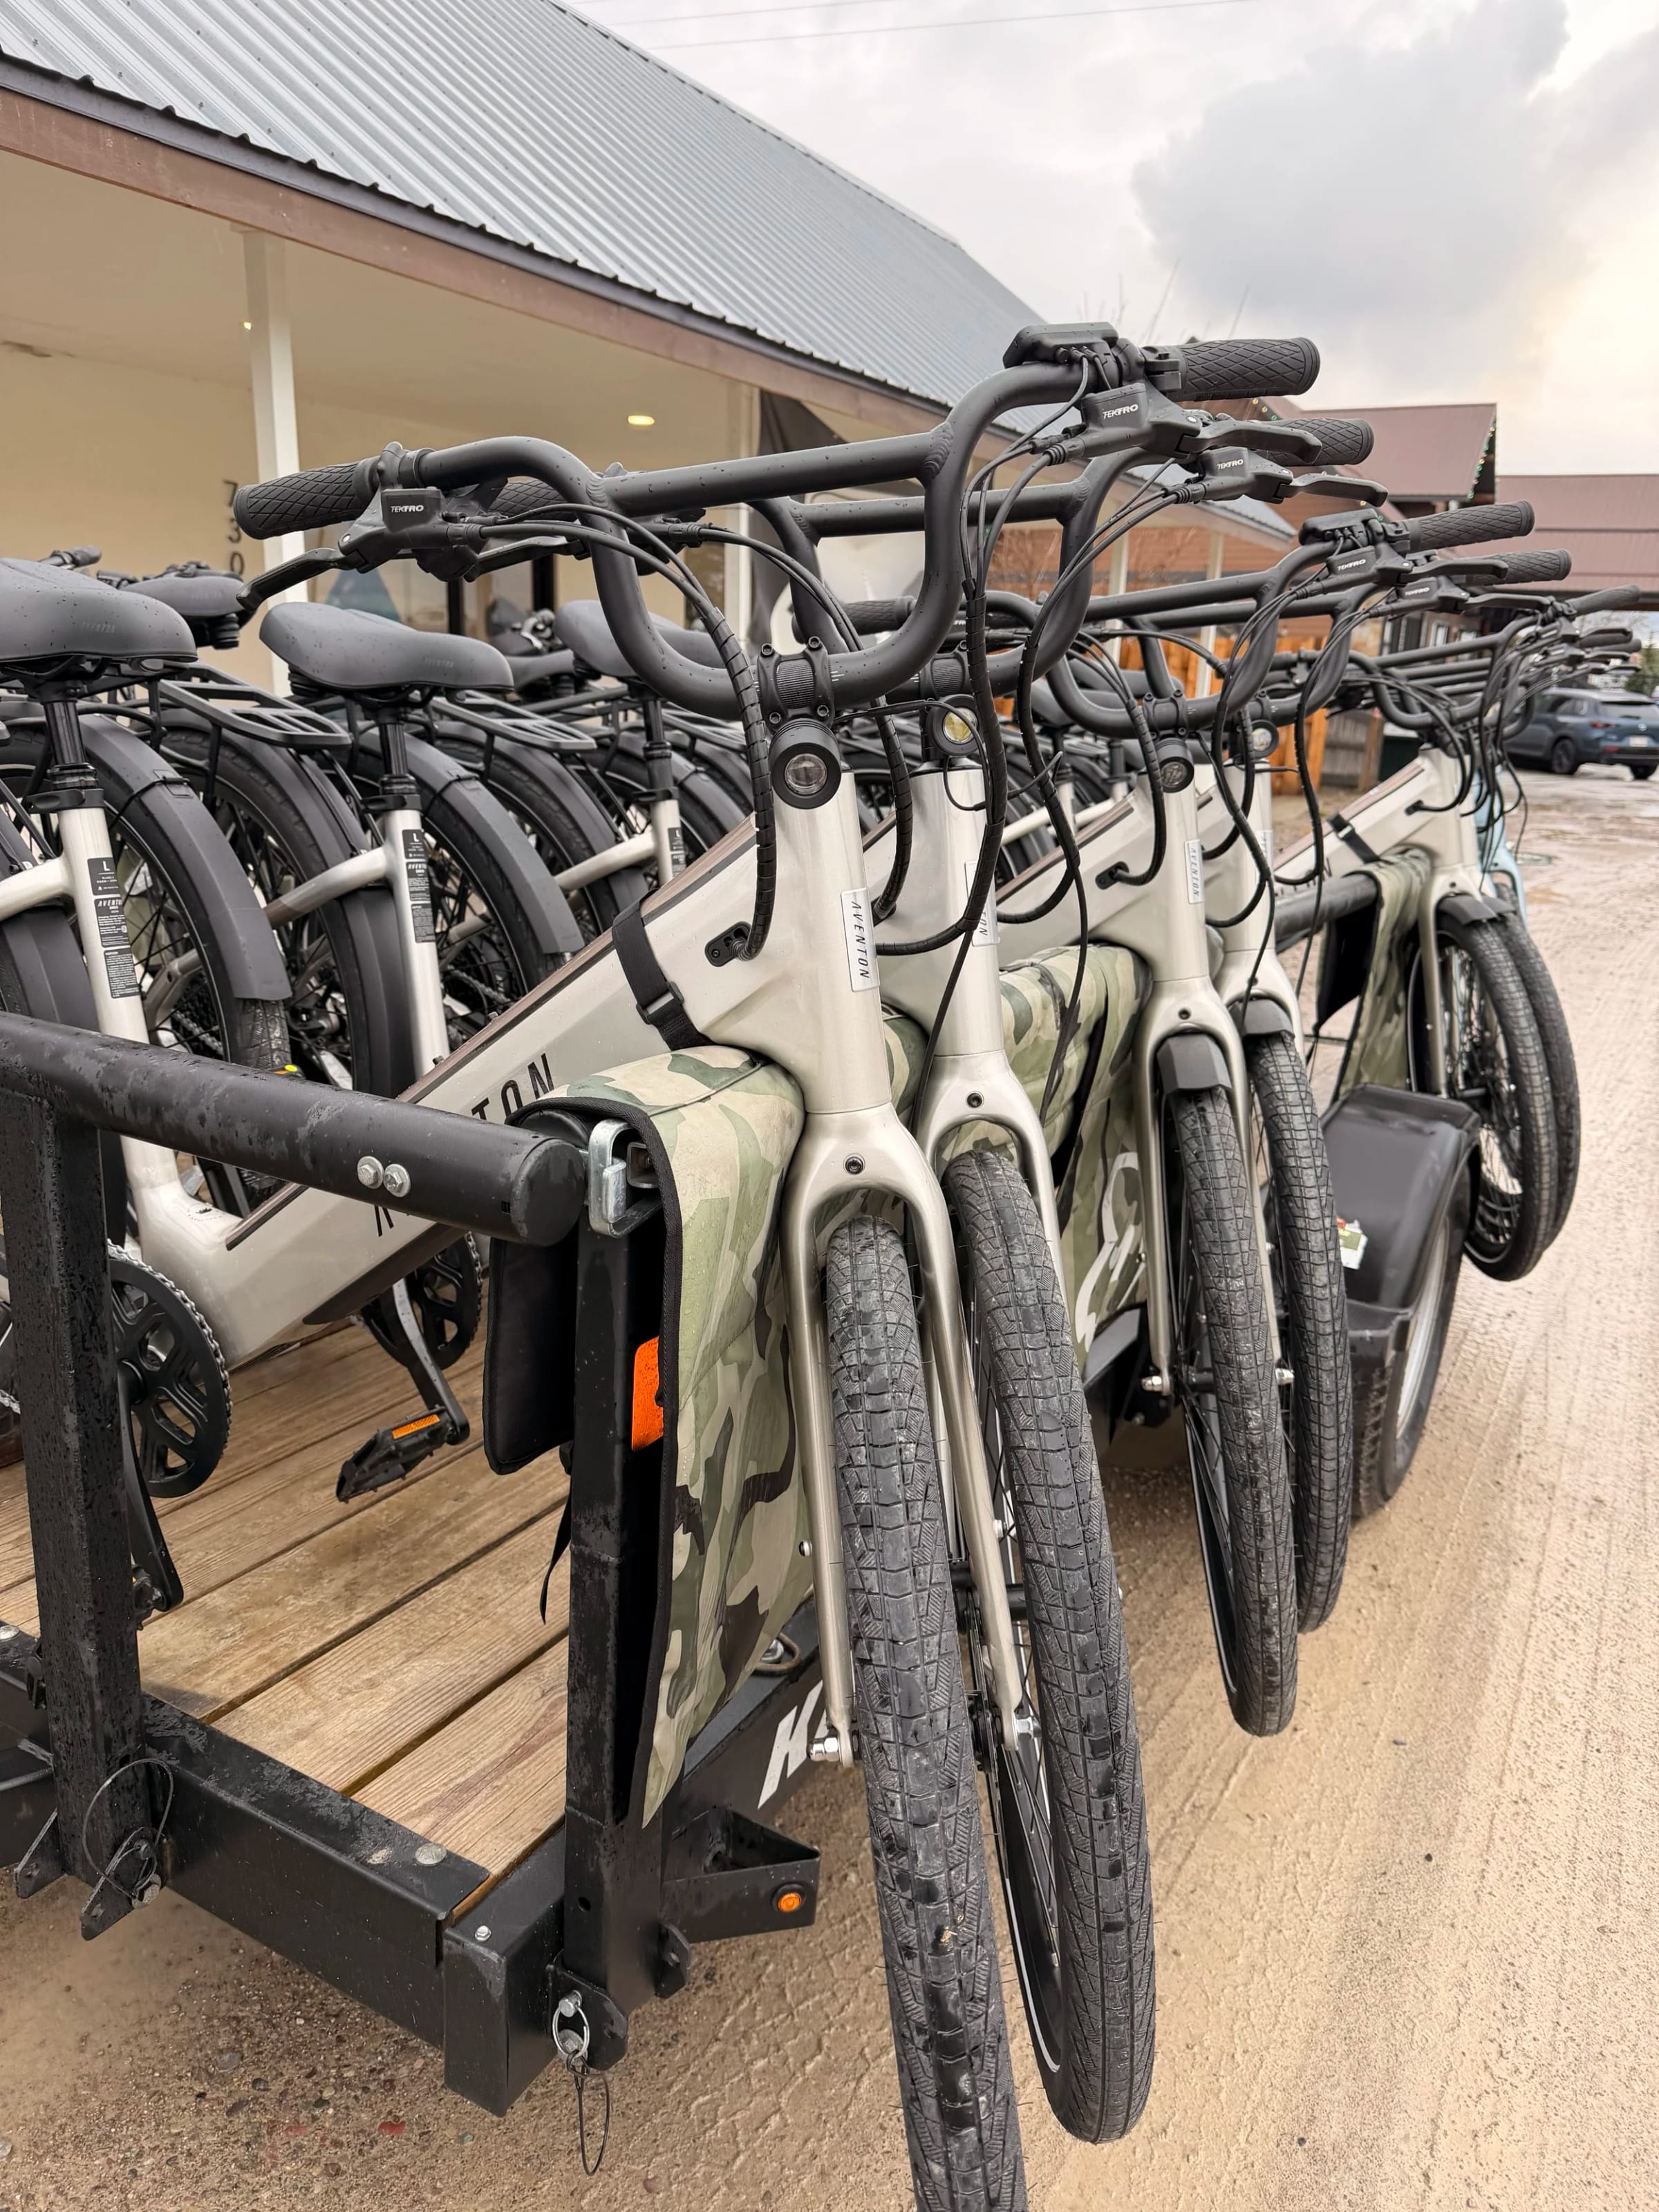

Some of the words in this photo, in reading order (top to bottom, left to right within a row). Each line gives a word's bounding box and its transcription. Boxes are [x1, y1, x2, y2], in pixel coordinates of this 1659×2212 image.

[1102, 404, 1139, 420] TEKTRO
[1217, 458, 1244, 470] TEKTRO
[390, 505, 424, 513] TEKTRO
[1337, 559, 1367, 571] TEKTRO
[413, 832, 420, 842] L
[102, 861, 111, 871] L
[1190, 847, 1200, 897] AVENTON
[851, 901, 870, 979] AVENTON
